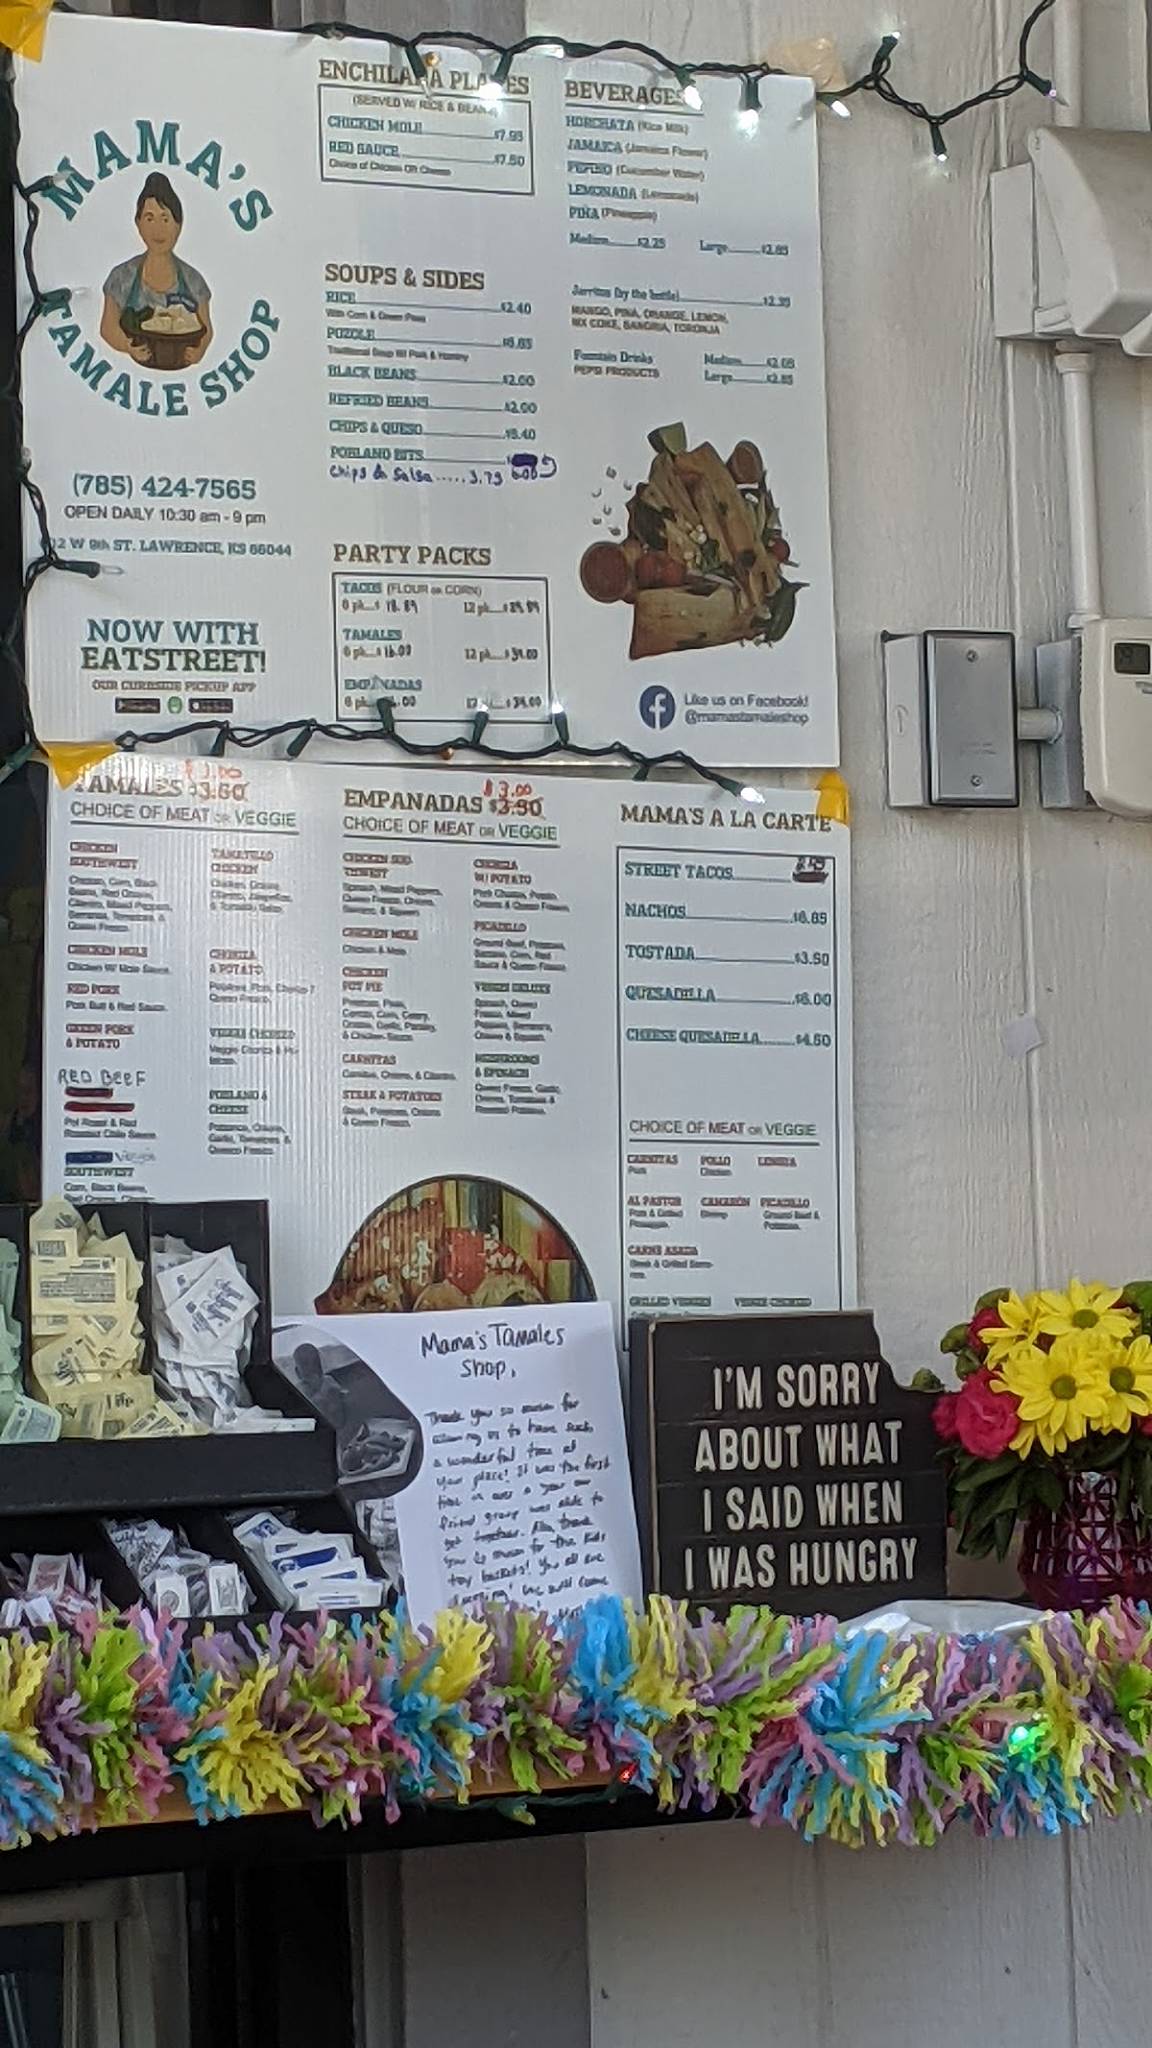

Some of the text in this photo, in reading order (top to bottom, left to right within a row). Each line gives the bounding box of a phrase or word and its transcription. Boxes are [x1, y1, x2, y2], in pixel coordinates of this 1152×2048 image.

[319, 59, 530, 95] ENCHILAA PLAES
[565, 80, 685, 106] BEVERAGES
[353, 96, 400, 108] (SERVED
[419, 100, 443, 111] RICE
[447, 102, 454, 112] &
[327, 115, 422, 134] CHICKEN MOLE
[566, 115, 634, 131] HORCHATA
[329, 141, 399, 157] RED SAUCE
[568, 139, 622, 153] JAMAICA
[495, 154, 525, 167] $7.50
[41, 119, 273, 232] MAMA'S
[568, 184, 637, 199] LEMONADA
[325, 263, 485, 290] SOUPS & SIDES
[326, 291, 356, 304] RICE
[632, 288, 647, 300] the
[501, 302, 531, 315] $2.40
[41, 297, 279, 417] TAMALE SHOP
[328, 364, 416, 381] BLACK BEANS
[605, 366, 660, 379] PRODUCTS
[329, 392, 429, 408] REFRIED BEANS
[329, 420, 422, 435] CHIPS & QUESO
[394, 448, 424, 461] BITS
[73, 473, 256, 500] (785) 424-7565
[64, 505, 266, 527] OPEN DAILY 10:30 am 9 pm
[71, 538, 86, 549] W
[113, 539, 136, 551] ST.
[140, 540, 224, 555] LAWRENCE,
[228, 543, 246, 555] KS
[250, 543, 292, 556] 66044
[333, 543, 492, 566] PARTY PACKS
[387, 583, 428, 596] (FLOUR
[445, 584, 482, 597] CORN)
[87, 618, 259, 645] NOW WITH
[342, 629, 402, 641] TAMALES
[81, 647, 266, 673] EATSTREET!
[684, 693, 809, 708] Like us on Facebook!
[344, 788, 483, 814] EMPANADAS
[70, 801, 135, 819] CHOICE
[140, 804, 162, 820] OF
[166, 806, 210, 823] MEAT
[235, 811, 296, 828] VEGGIE
[620, 803, 832, 832] MAMA'S A LA CARTE
[343, 816, 402, 833] CHOICE
[408, 819, 429, 834] OF
[434, 821, 475, 837] MEAT
[499, 824, 557, 840] VEGGIE
[625, 861, 734, 881] STREET TACOS
[625, 902, 687, 919] NACHOS
[625, 944, 696, 960] TOSTADA
[625, 985, 716, 1002] QUESADILLA
[626, 1028, 760, 1045] CHEESE QUESADILLA
[629, 1120, 682, 1134] CHOICE
[686, 1121, 704, 1134] OF
[708, 1122, 745, 1134] MEAT
[765, 1123, 816, 1136] VEGGIE
[701, 1156, 731, 1166] POLLO
[421, 1331, 487, 1358] Mama's
[713, 1361, 880, 1410] I'M SORRY
[695, 1420, 902, 1472] ABOUT WHAT
[703, 1480, 902, 1533] I SAID WHEN
[685, 1537, 917, 1591] I WAS HUNGRY
